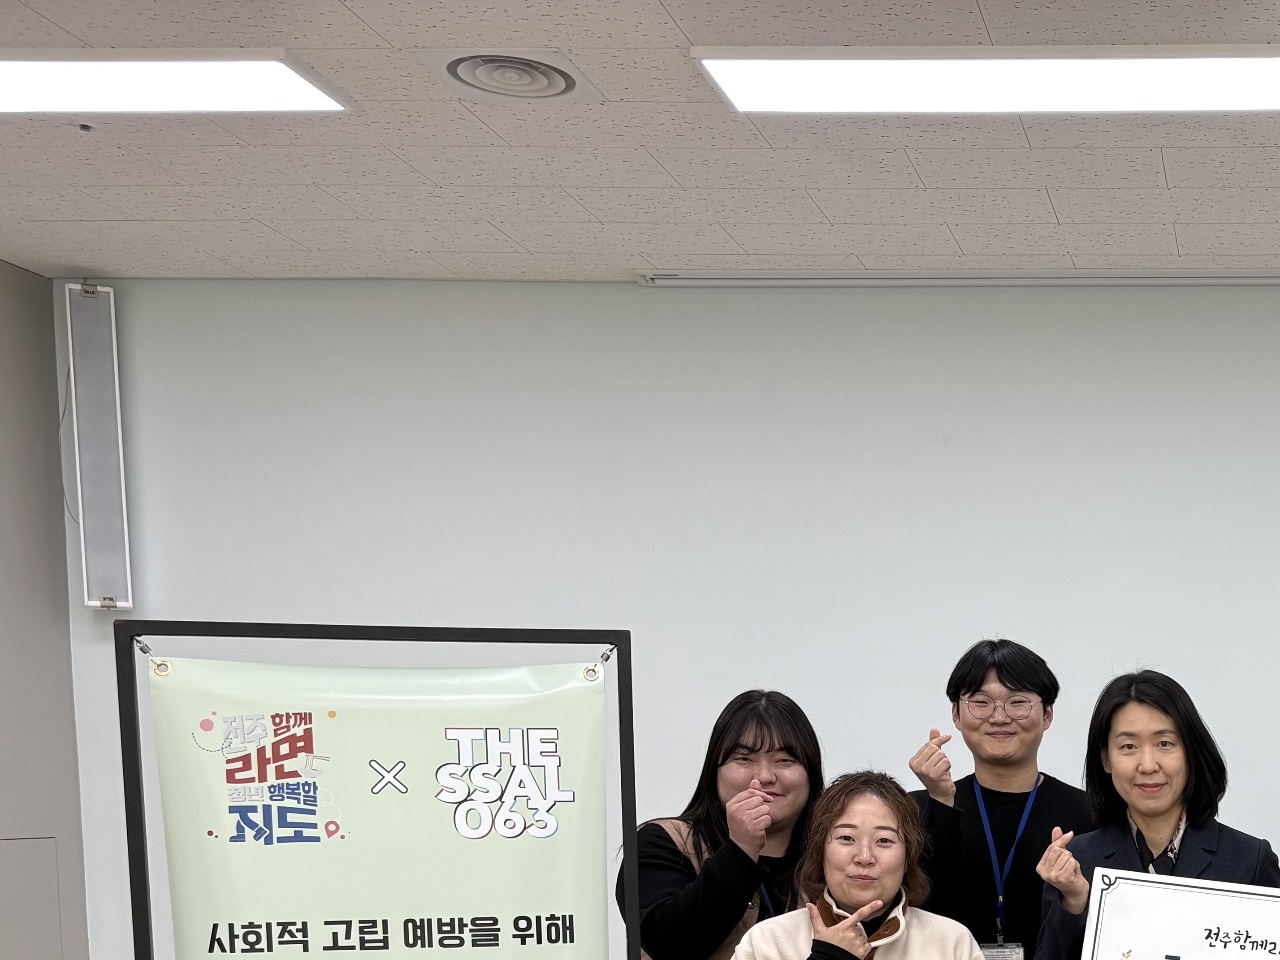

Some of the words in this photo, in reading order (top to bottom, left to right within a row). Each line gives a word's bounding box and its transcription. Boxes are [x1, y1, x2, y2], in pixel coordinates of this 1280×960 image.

[222, 713, 268, 754] 전주
[271, 711, 313, 738] 함께
[444, 727, 561, 768] THE
[225, 728, 315, 784] 라면
[228, 785, 264, 802] 청년
[267, 781, 319, 807] 행복할
[434, 763, 576, 804] SSAL
[228, 804, 321, 845] 지도
[453, 801, 560, 839] 063
[208, 922, 309, 953] 사회적
[323, 919, 389, 951] 고립
[404, 917, 500, 948] 예방을
[512, 914, 574, 945] 위해
